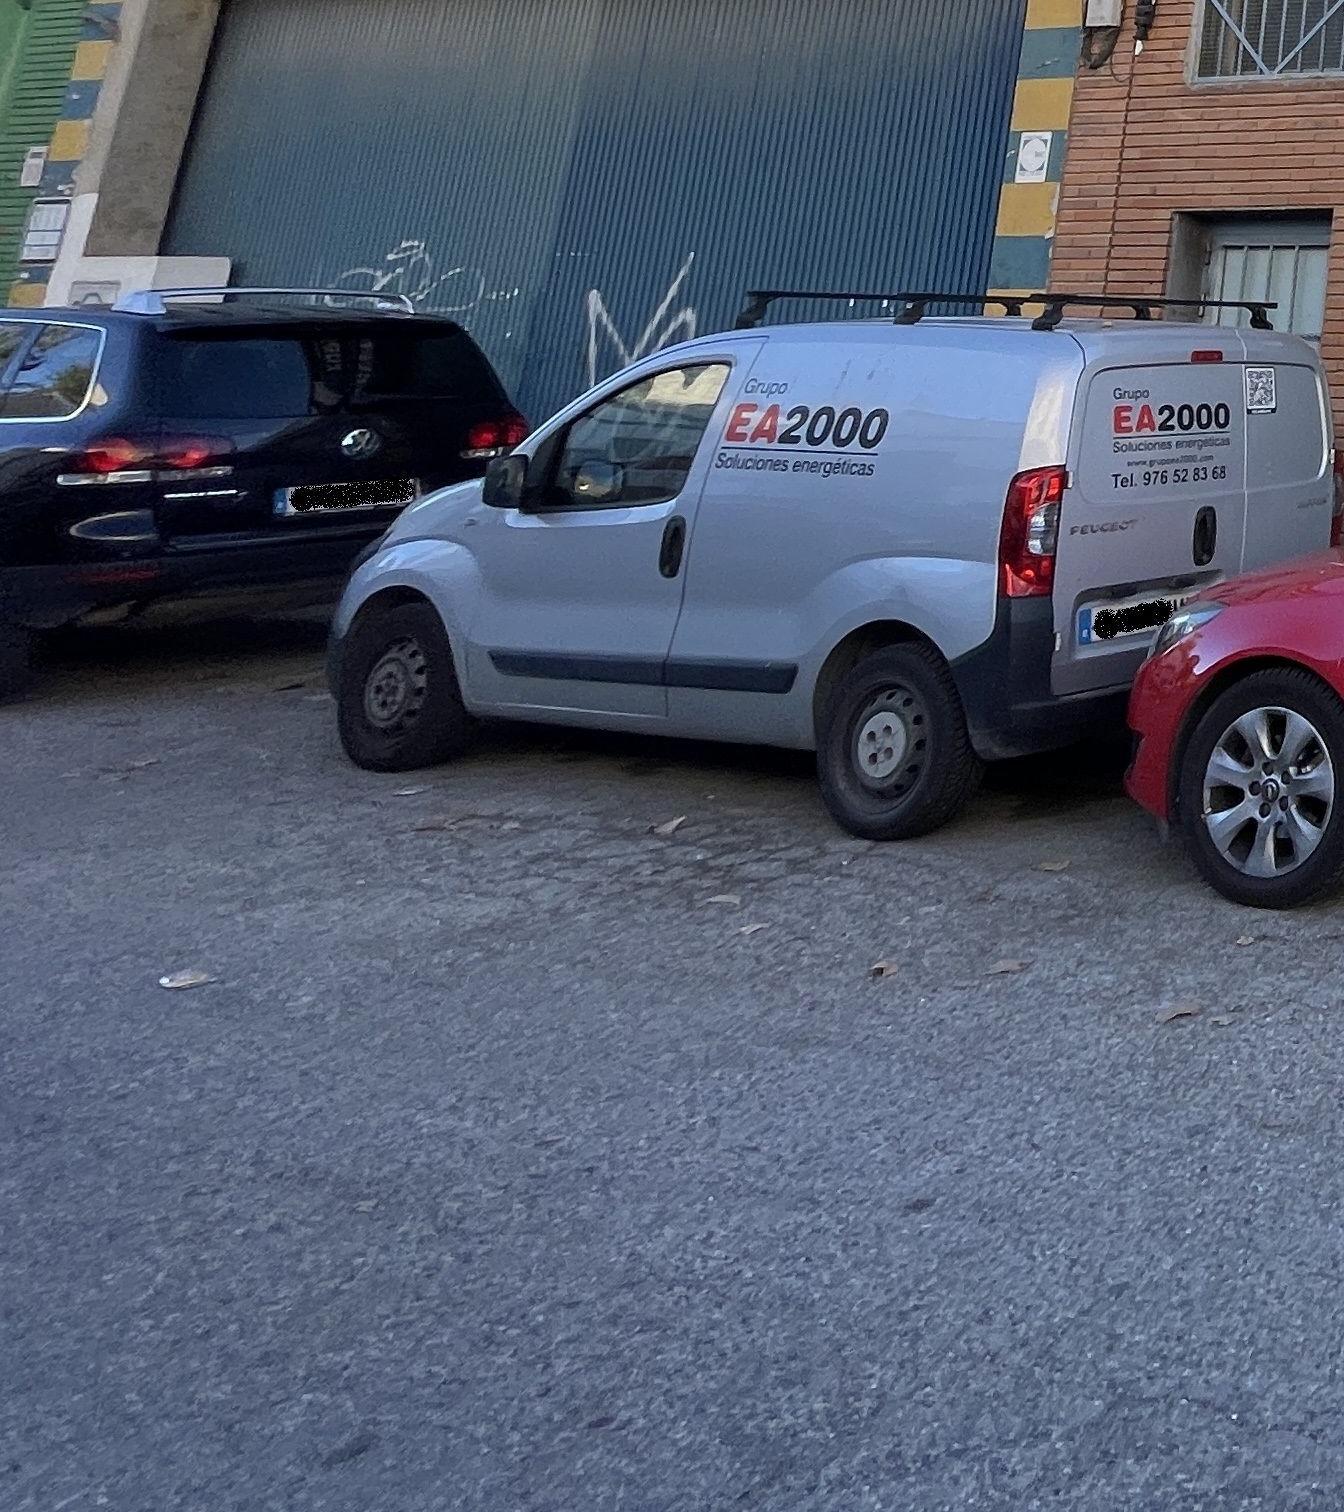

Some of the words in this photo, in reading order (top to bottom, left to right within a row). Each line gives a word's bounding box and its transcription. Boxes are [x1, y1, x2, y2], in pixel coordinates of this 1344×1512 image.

[744, 377, 788, 398] Grupo
[1113, 387, 1150, 401] Grupo
[726, 403, 889, 449] EA2000
[1113, 402, 1231, 434] EA2000
[1112, 440, 1173, 454] Soluciones
[714, 452, 789, 473] Soluciones
[792, 458, 876, 479] energéticas
[1111, 472, 1138, 489] Tel.
[1142, 470, 1168, 486] 976
[1172, 468, 1189, 483] 52
[1192, 467, 1208, 481] 83
[1211, 465, 1227, 480] 68
